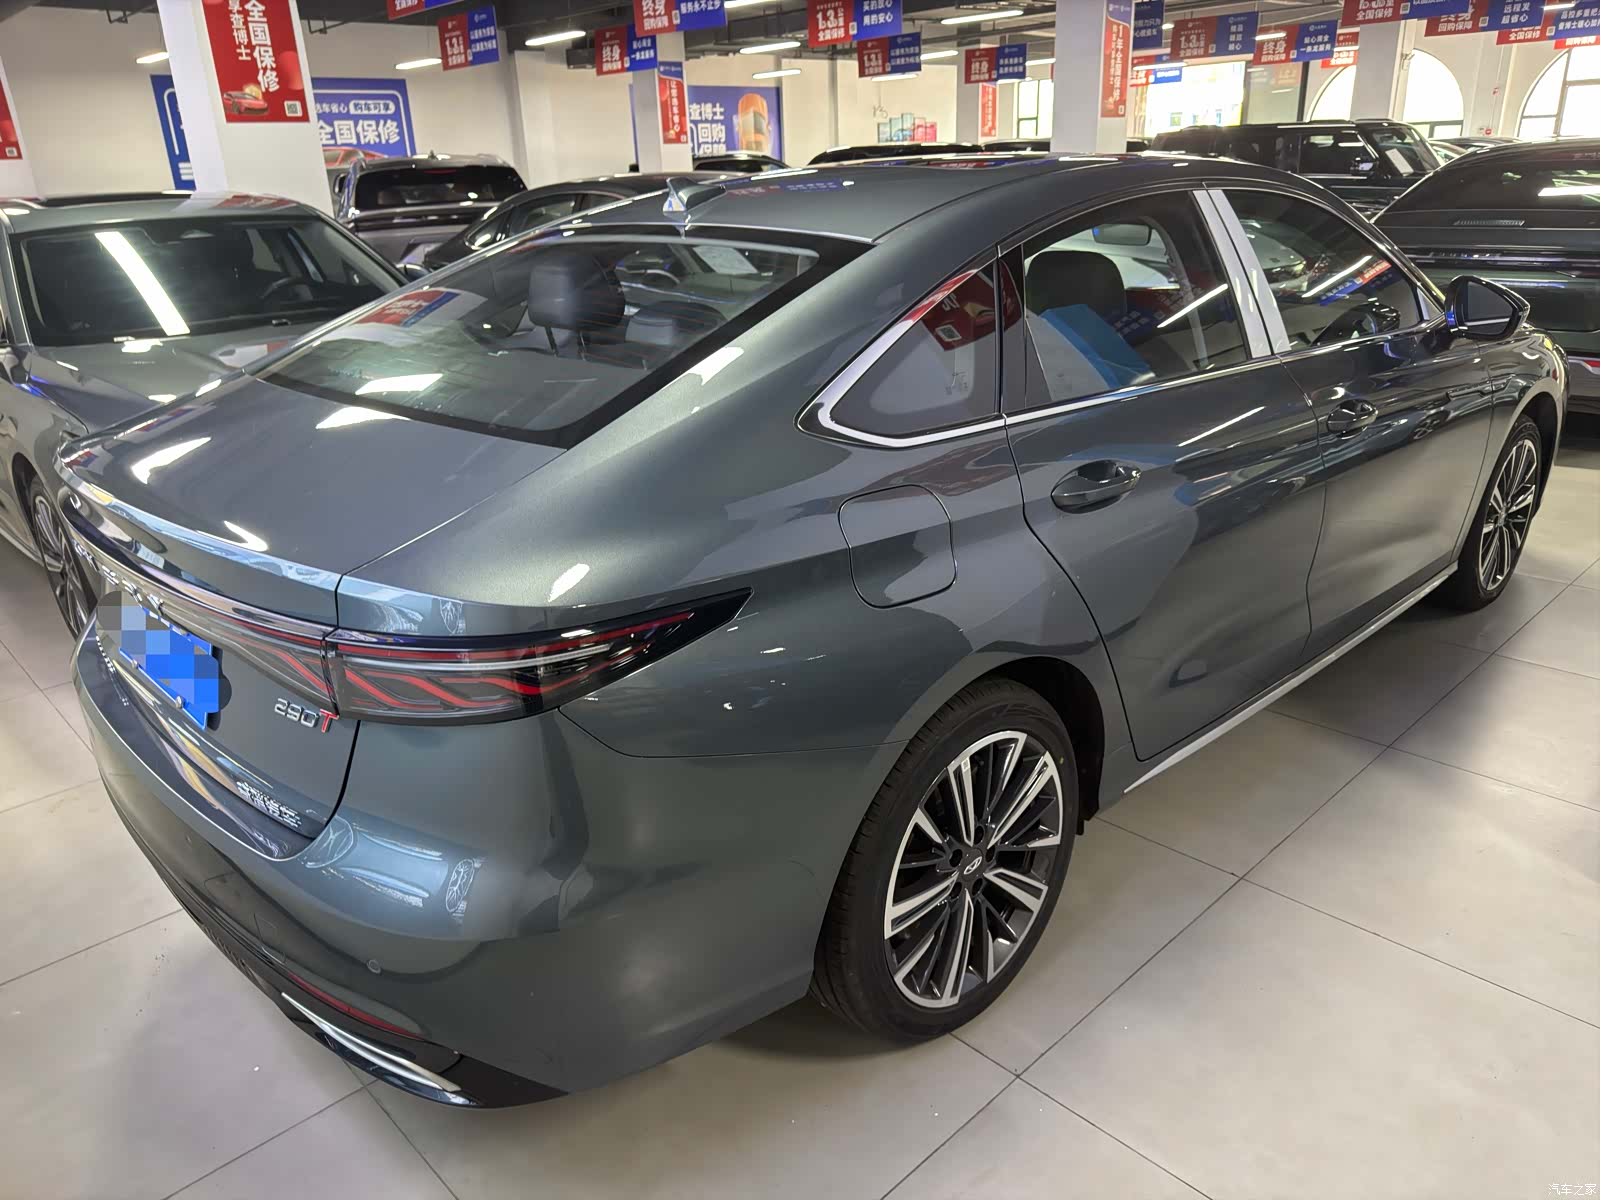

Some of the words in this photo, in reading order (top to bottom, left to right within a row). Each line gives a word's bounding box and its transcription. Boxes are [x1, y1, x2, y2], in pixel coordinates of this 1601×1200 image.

[863, 12, 893, 26] 用的安心
[1356, 8, 1393, 20] 全国保修
[1501, 14, 1528, 24] 超省心
[1438, 21, 1472, 32] 回购保障
[818, 28, 845, 41] 全国保修
[1508, 30, 1540, 40] 全国保修
[244, 0, 280, 92] 全国保修
[602, 45, 620, 61] 终身
[1263, 40, 1287, 54] 终身
[689, 102, 725, 120] 查博士
[318, 119, 401, 145] 全国保修
[698, 122, 726, 143] 回购
[274, 697, 339, 733] 290T
